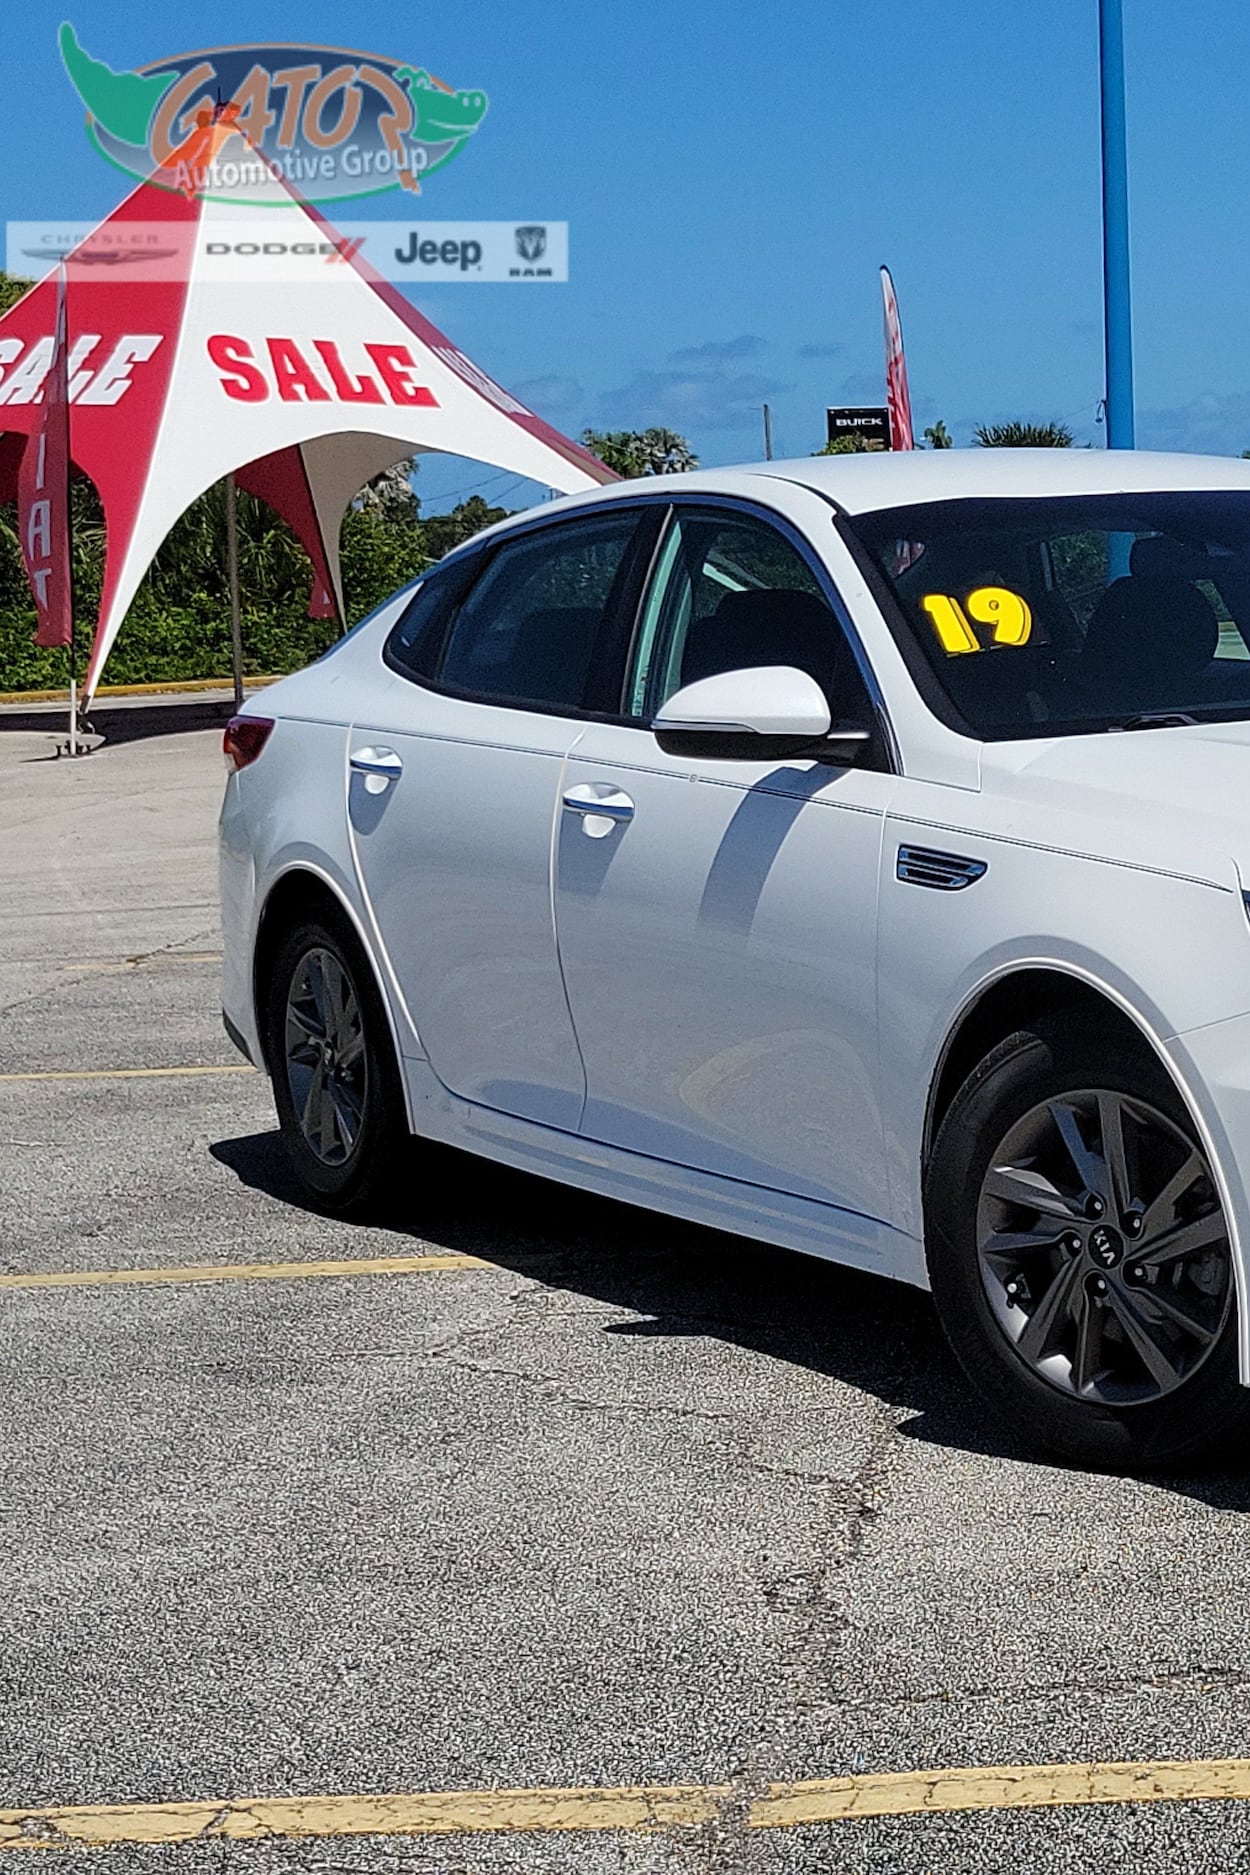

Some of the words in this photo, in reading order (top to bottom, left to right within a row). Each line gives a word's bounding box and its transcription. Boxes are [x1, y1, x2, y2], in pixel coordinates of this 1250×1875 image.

[207, 334, 442, 409] SALE
[836, 417, 884, 426] BUICK
[923, 587, 1032, 654] 19
[1094, 1229, 1116, 1266] KIA
